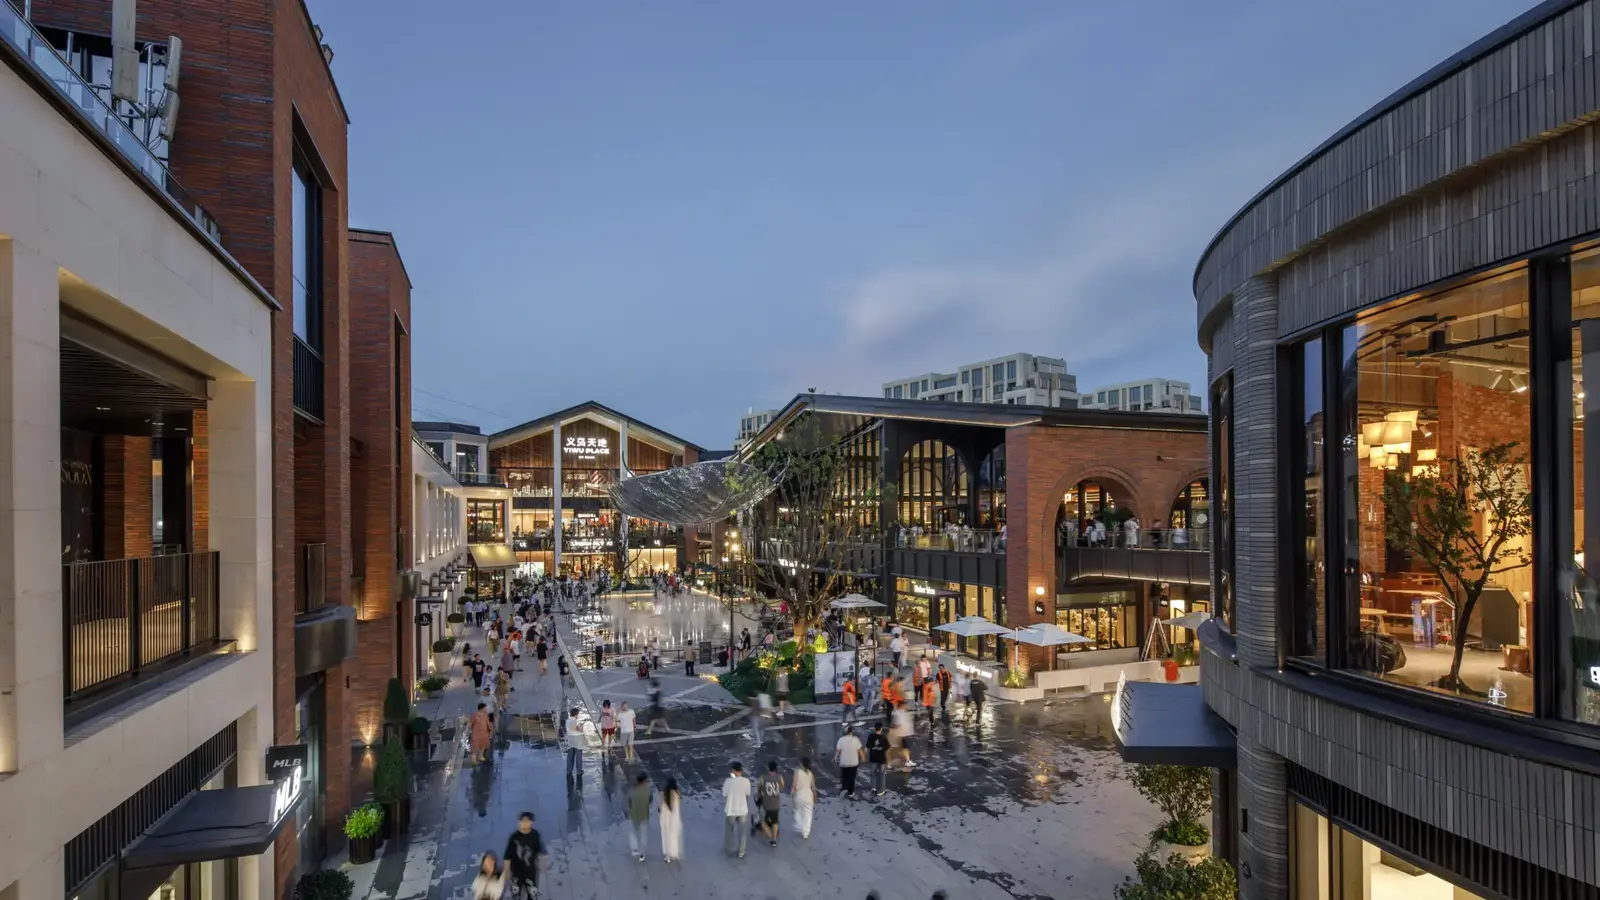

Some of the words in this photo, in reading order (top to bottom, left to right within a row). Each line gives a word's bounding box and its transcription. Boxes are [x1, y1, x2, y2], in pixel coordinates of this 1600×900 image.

[566, 437, 608, 448] 义乌天地
[585, 447, 610, 455] PLACE
[273, 758, 302, 768] MLB
[273, 765, 302, 823] MLB
